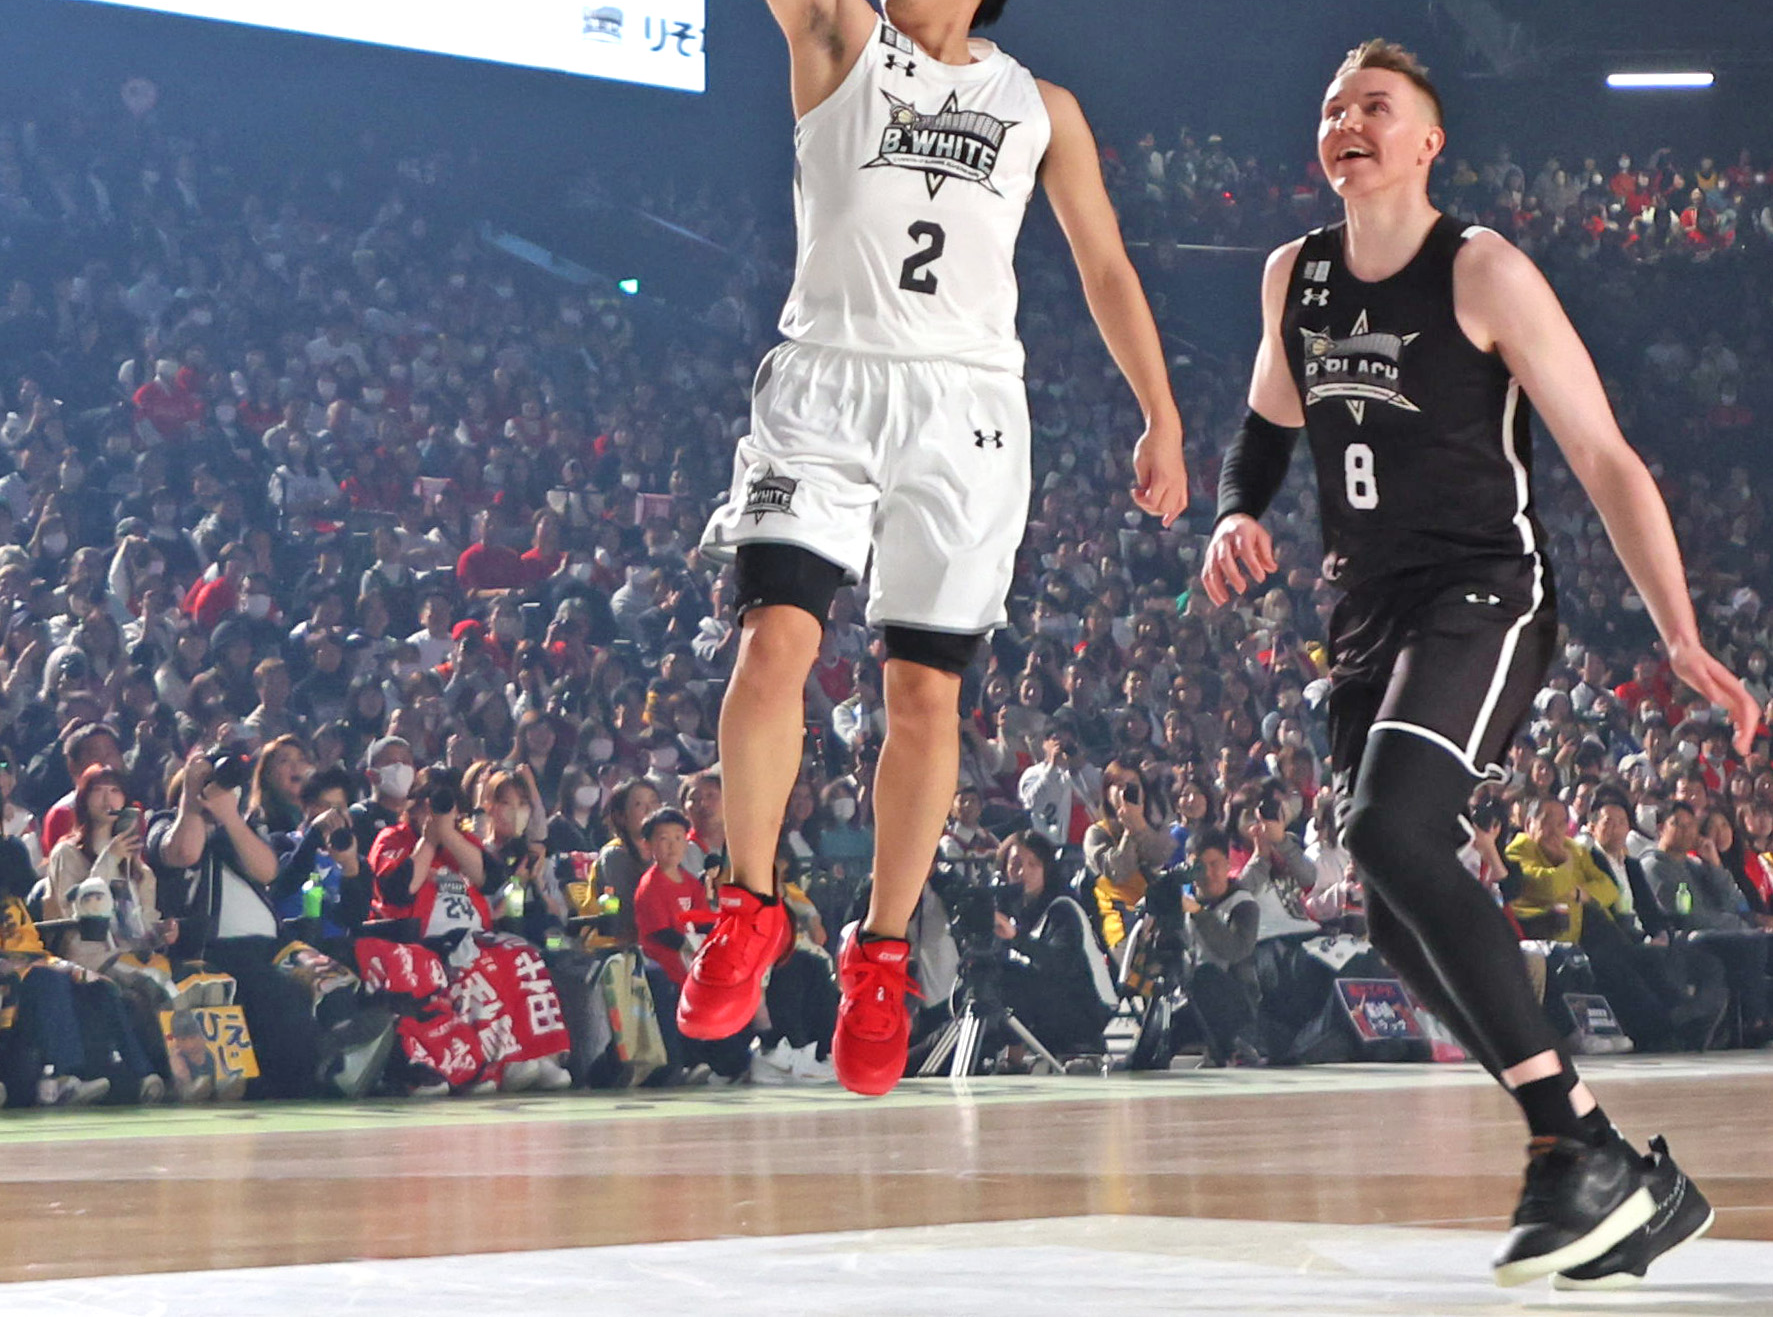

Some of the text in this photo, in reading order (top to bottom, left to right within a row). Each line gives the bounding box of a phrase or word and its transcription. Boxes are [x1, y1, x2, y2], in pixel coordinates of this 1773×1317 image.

[881, 127, 997, 174] B.WHITE
[899, 219, 946, 294] 2
[1344, 442, 1379, 510] 8
[443, 897, 474, 921] 24
